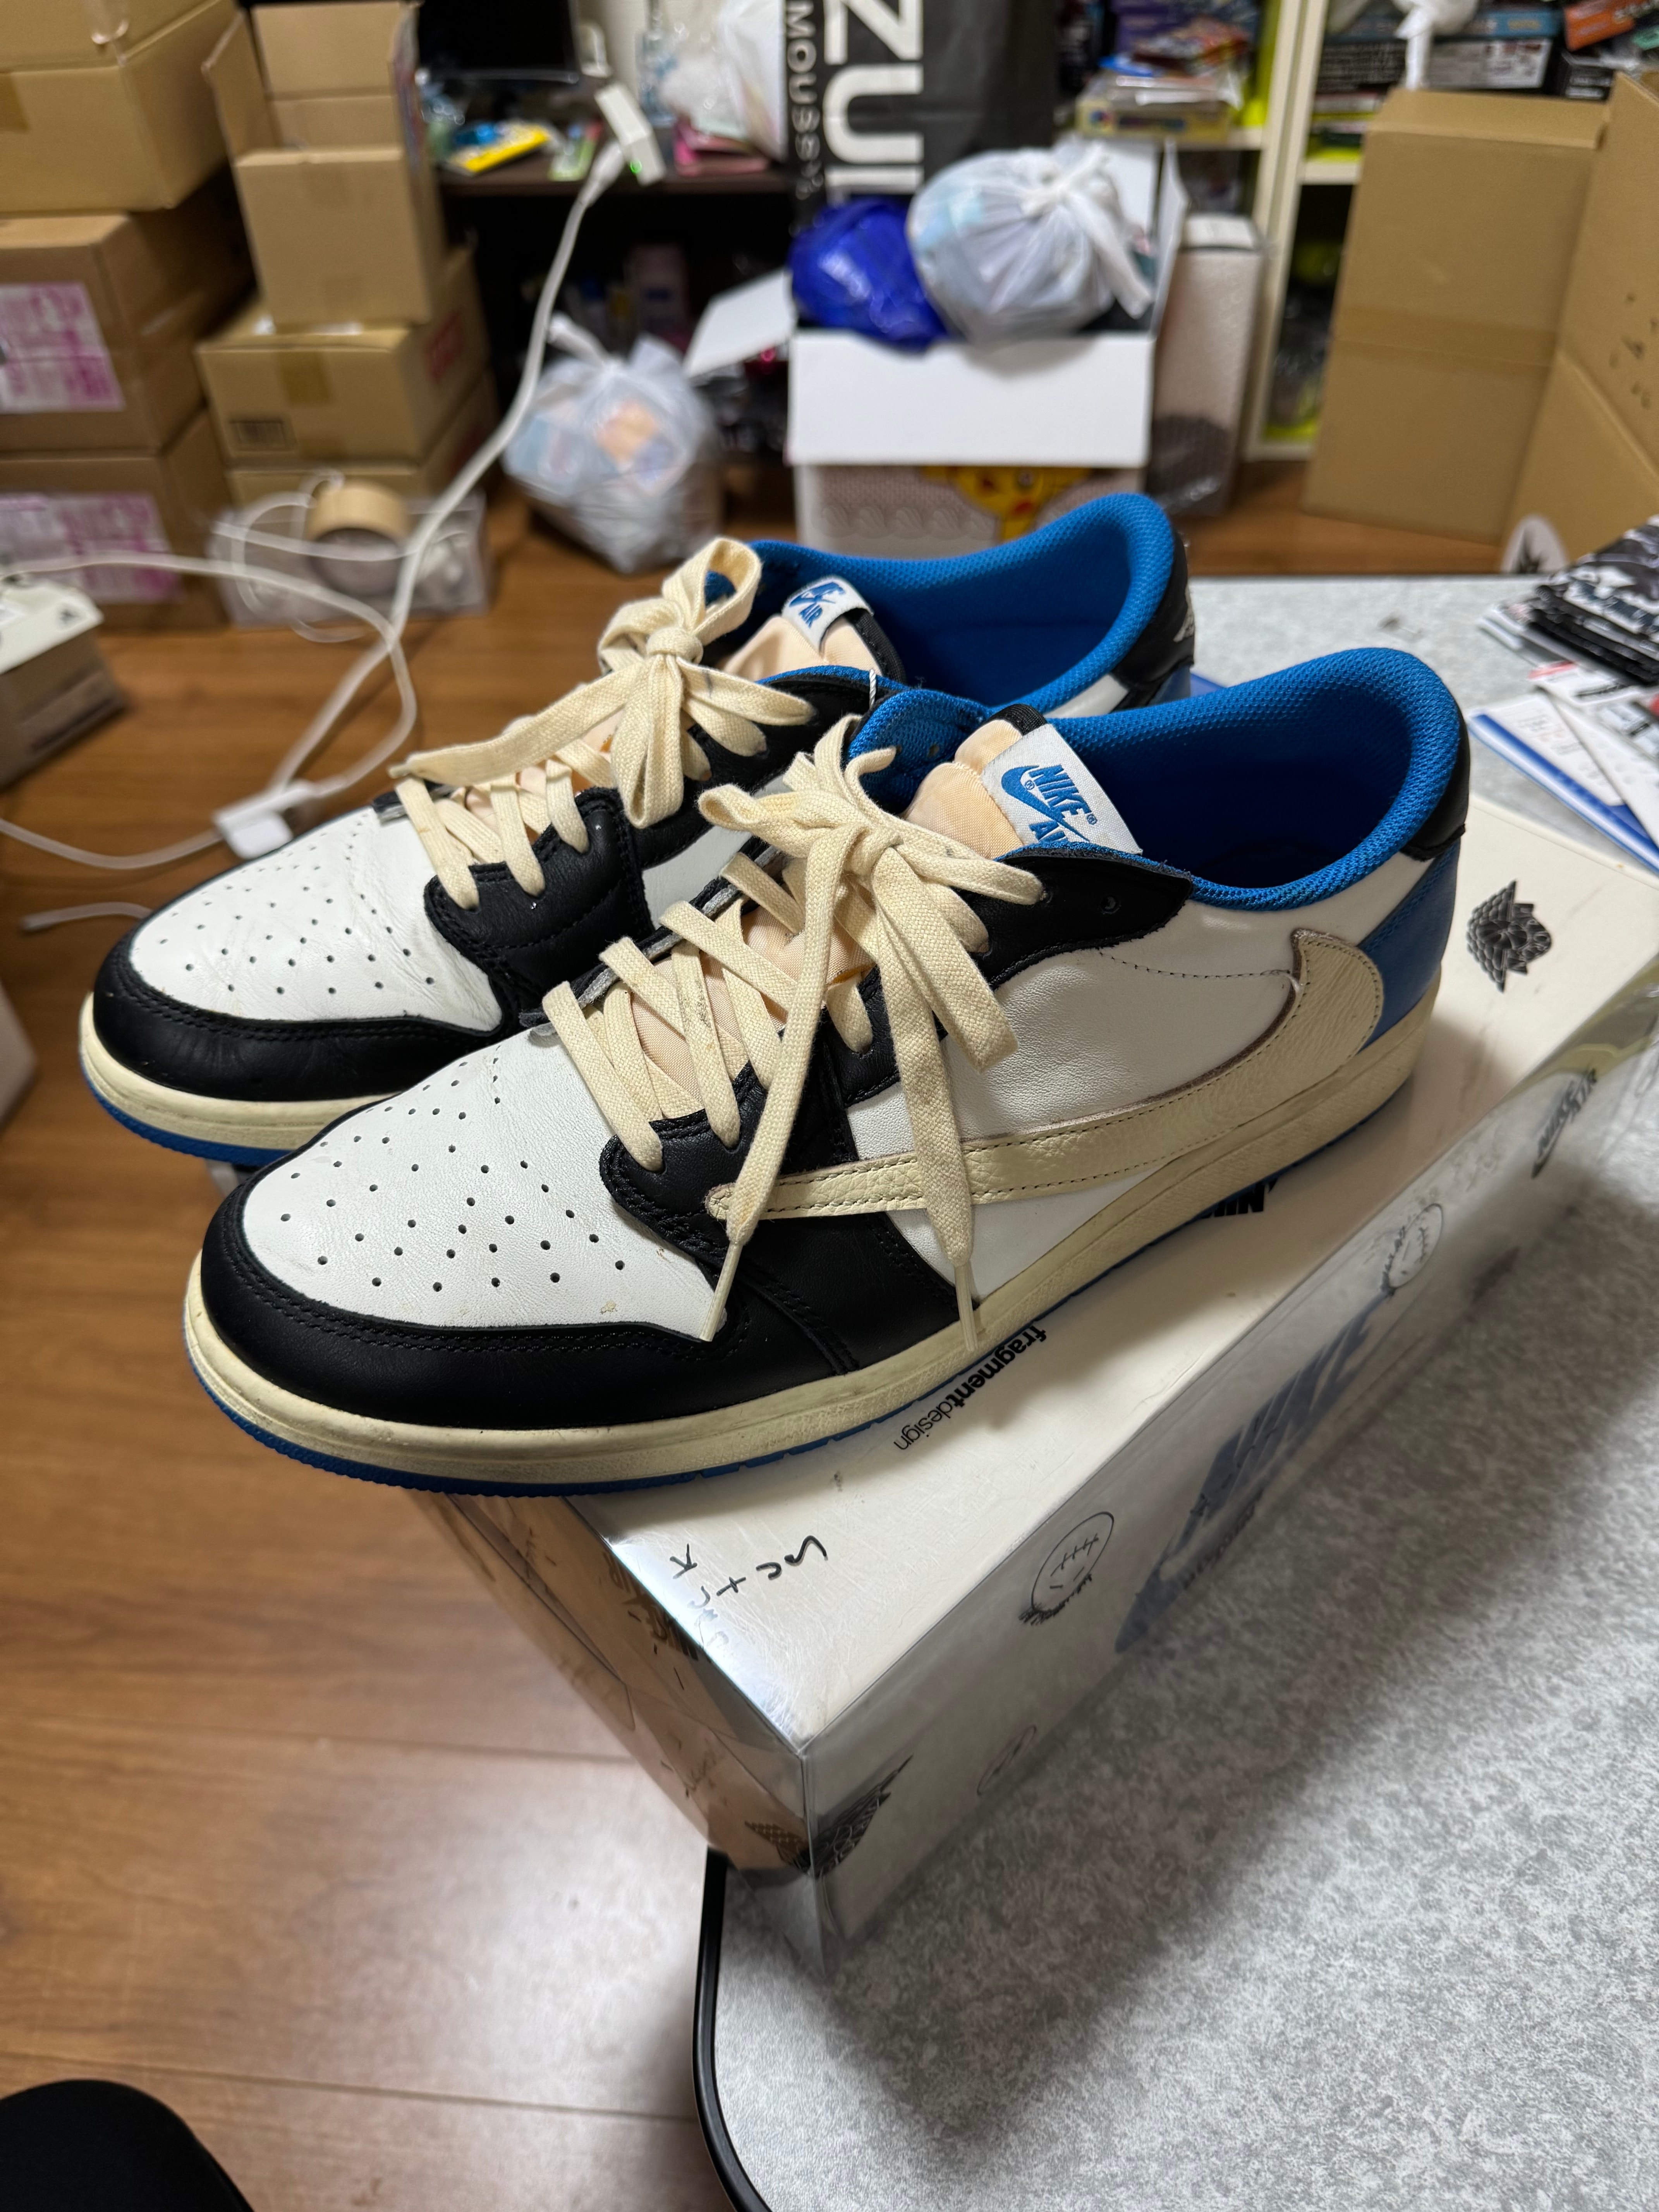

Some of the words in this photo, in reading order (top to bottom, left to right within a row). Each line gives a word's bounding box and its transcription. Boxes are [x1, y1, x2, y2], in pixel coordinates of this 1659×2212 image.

[1028, 764, 1092, 816] NIKE
[1029, 821, 1070, 843] AI
[893, 1325, 1047, 1450] fragmentdesign
